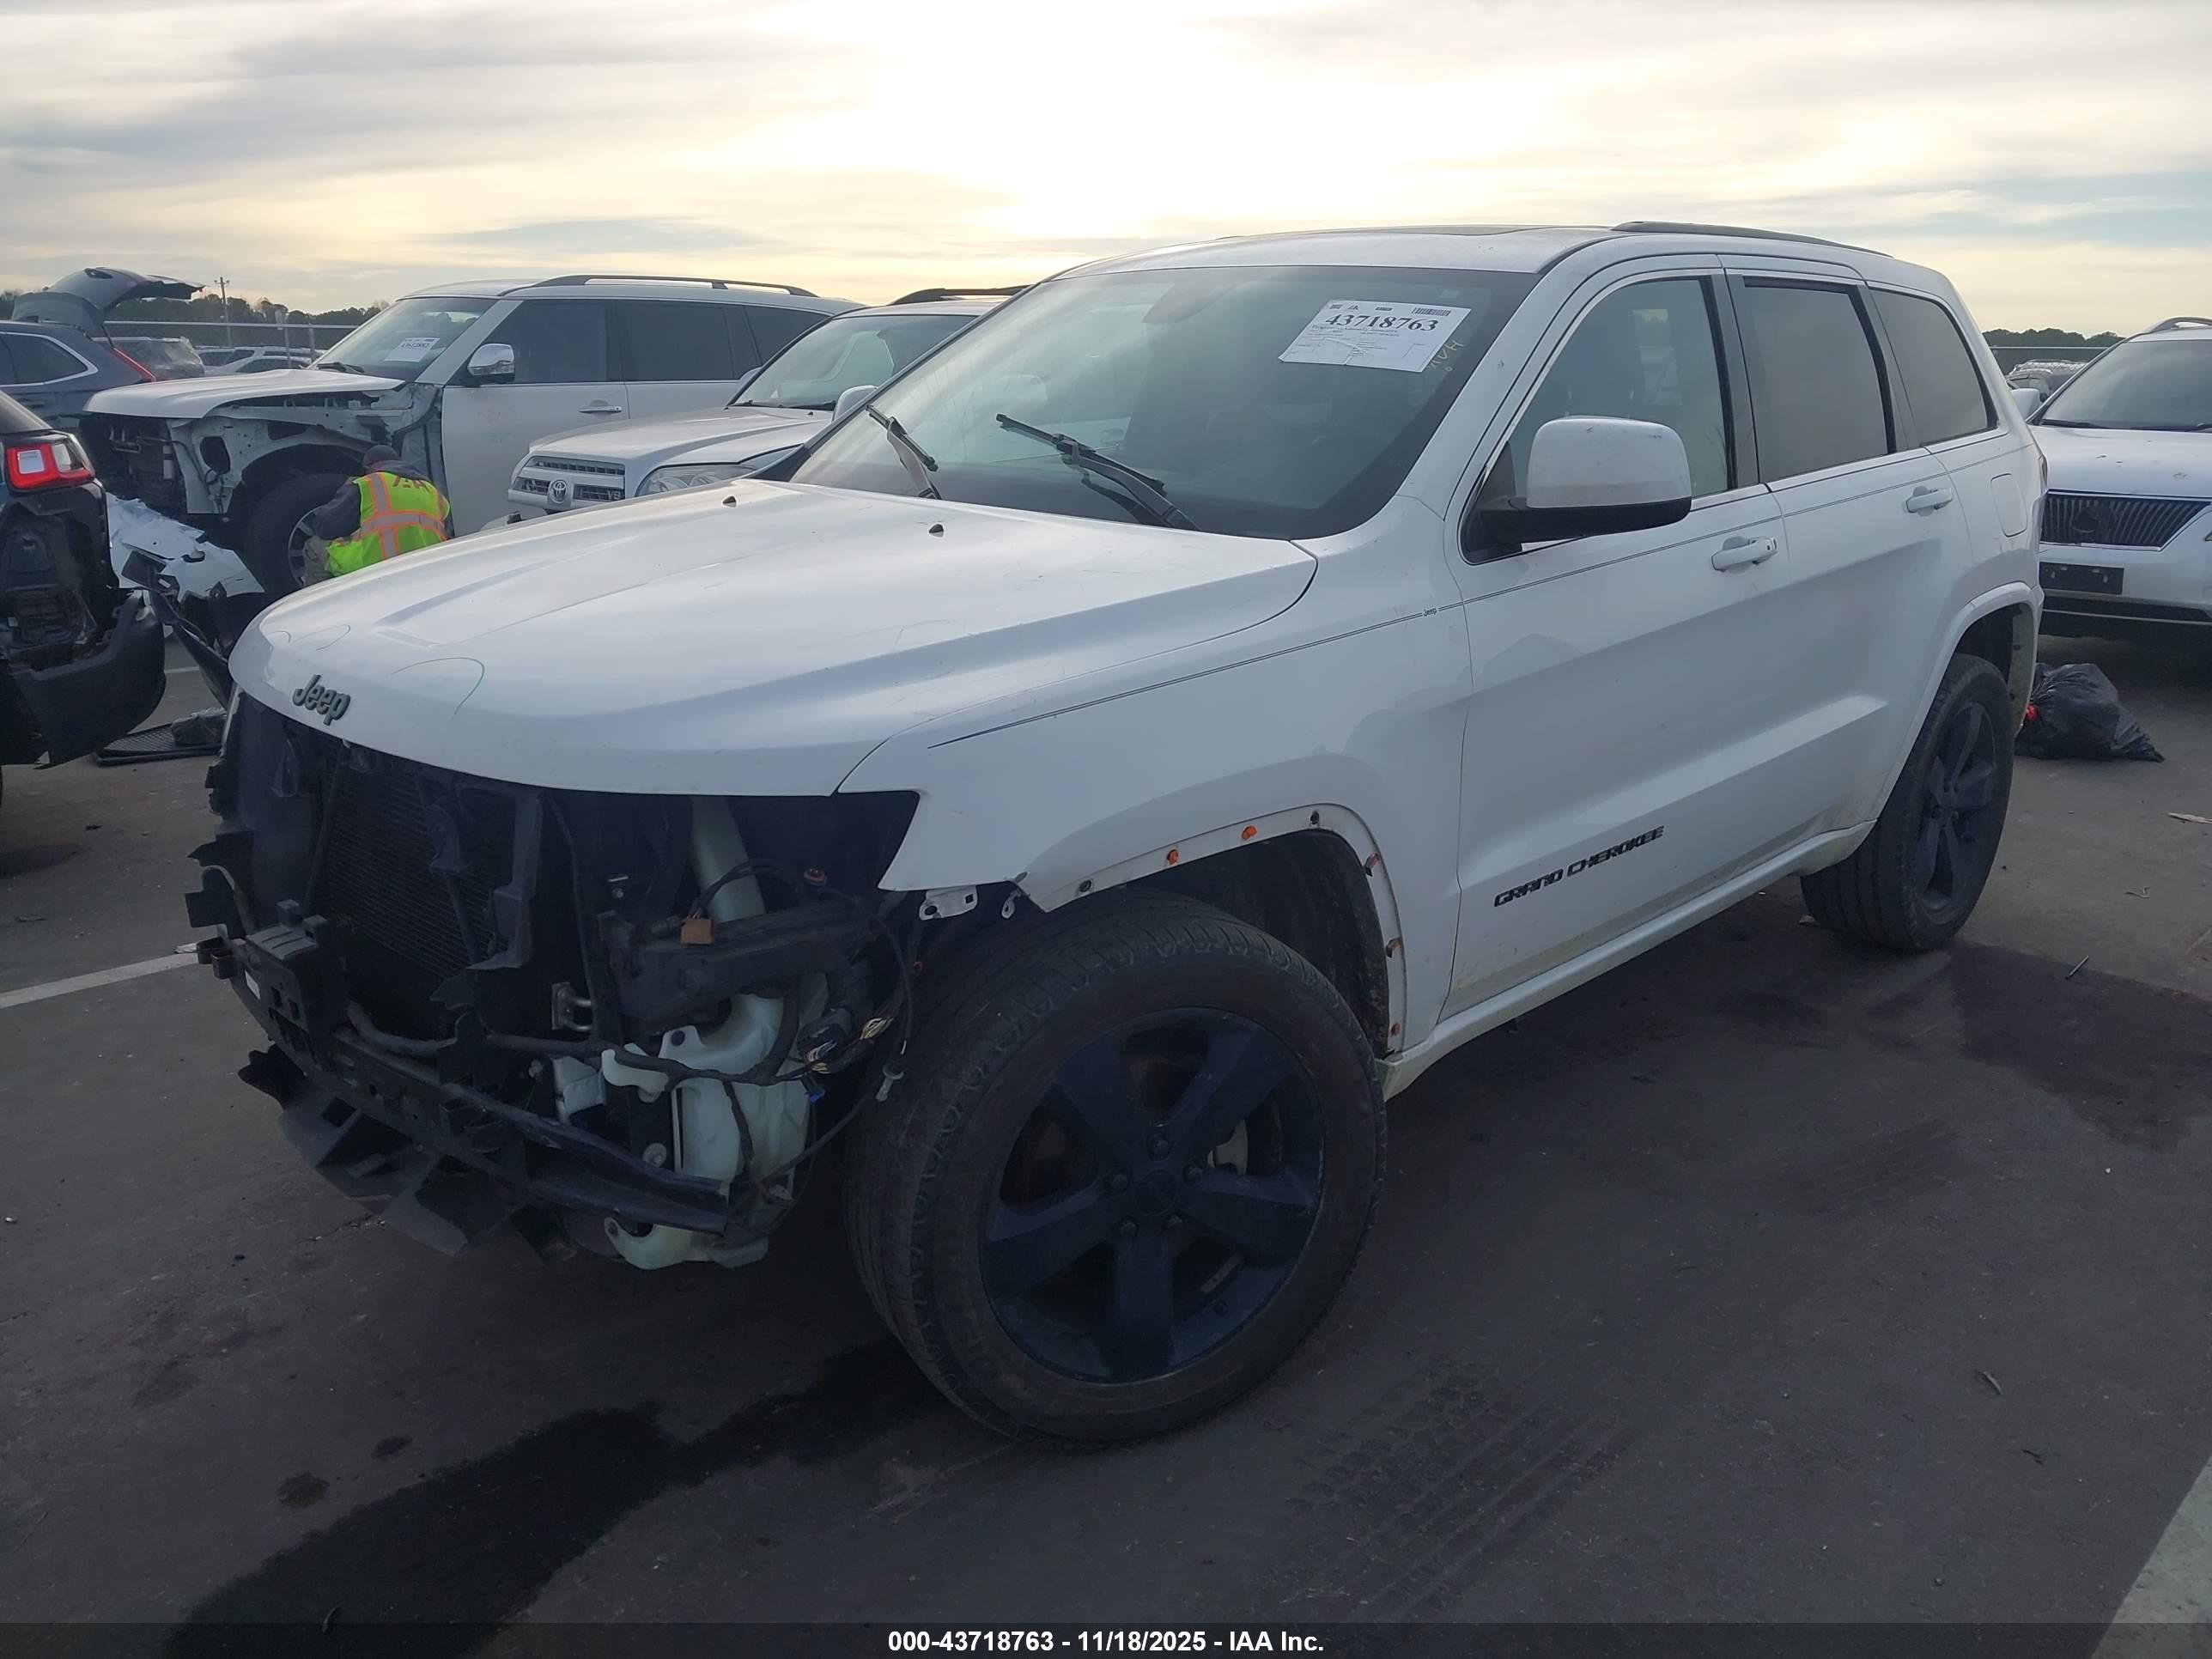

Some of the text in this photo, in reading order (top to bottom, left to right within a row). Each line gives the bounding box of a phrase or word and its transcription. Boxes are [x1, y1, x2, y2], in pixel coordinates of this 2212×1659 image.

[1325, 314, 1439, 331] 43718763
[1423, 608, 1437, 617] Jeep
[292, 674, 351, 726] Jeep
[1493, 825, 1665, 908] GRAND CHEROKEE
